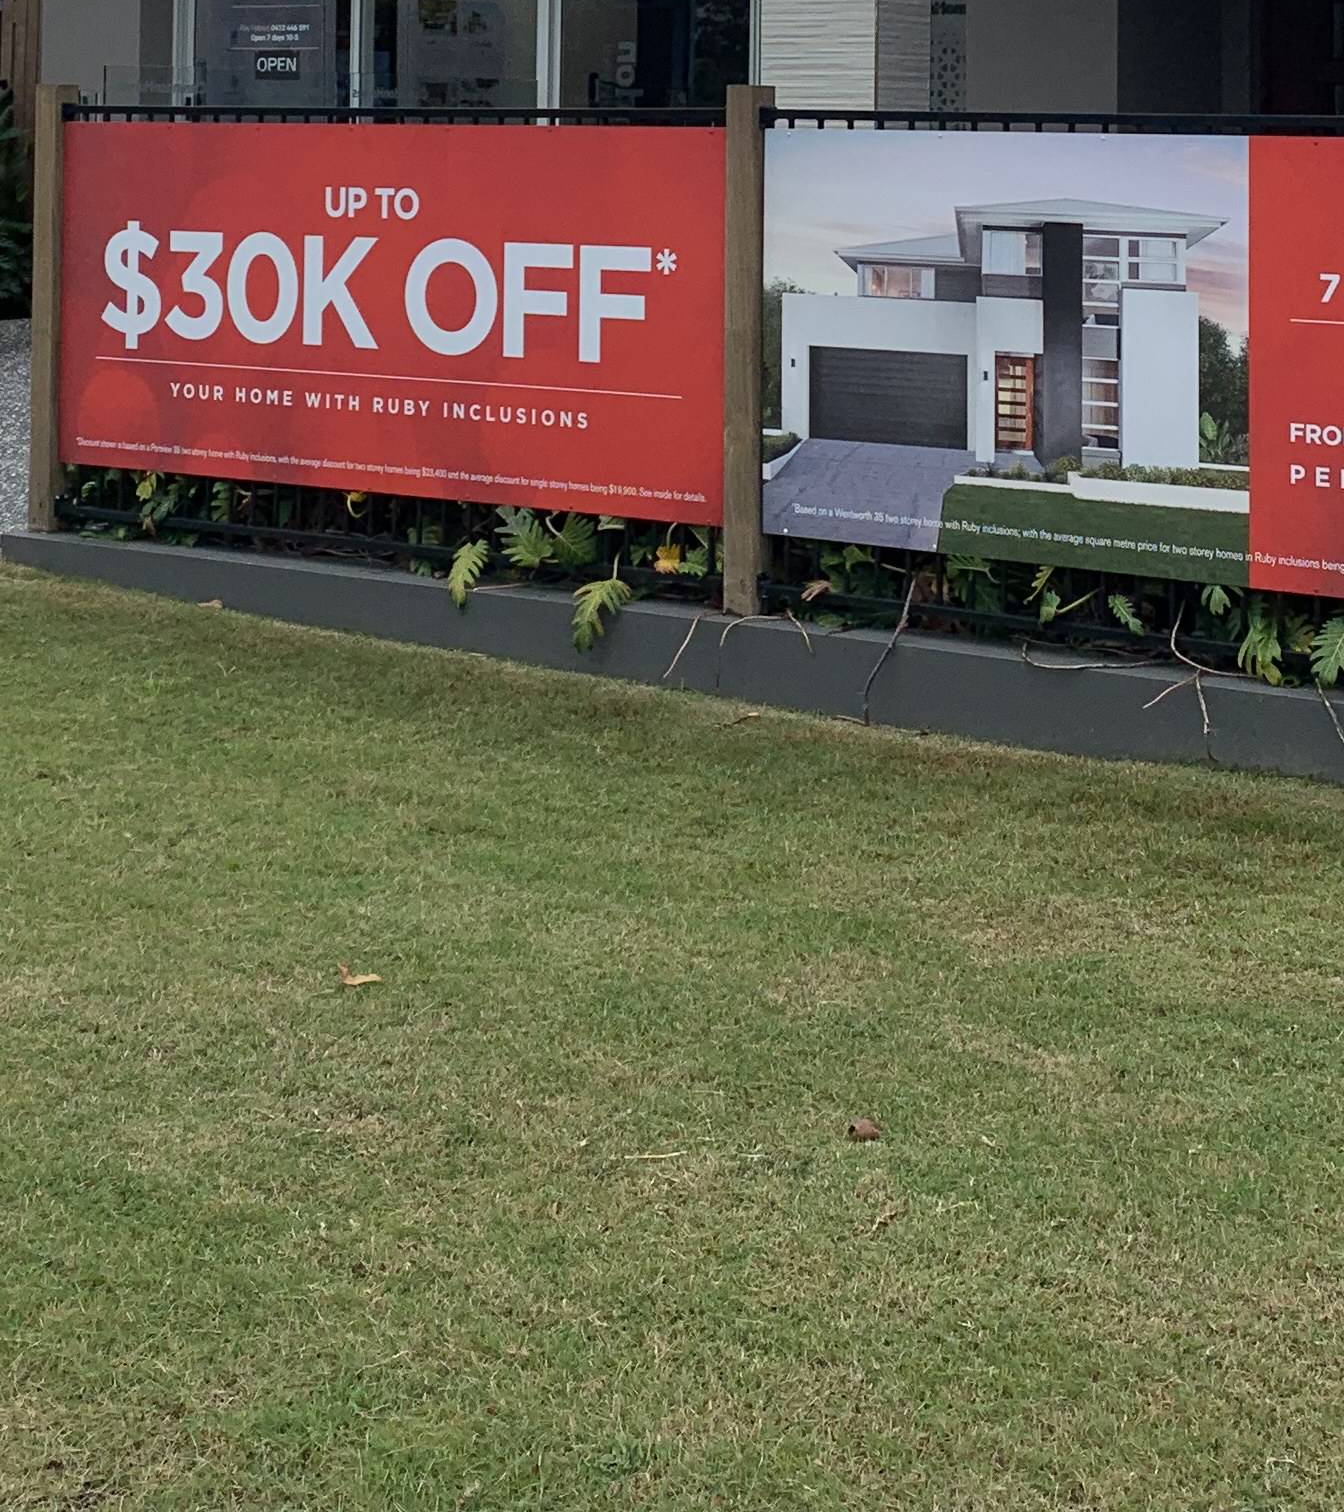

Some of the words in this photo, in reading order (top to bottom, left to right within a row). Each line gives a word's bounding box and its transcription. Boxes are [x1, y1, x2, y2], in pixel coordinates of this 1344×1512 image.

[256, 57, 297, 72] OPEN
[324, 186, 367, 219] UP
[374, 187, 420, 220] TO
[101, 220, 380, 350] $30K
[1319, 273, 1341, 304] 7
[170, 382, 224, 402] YOUR
[235, 387, 294, 407] HOME
[305, 392, 360, 412] WITH
[372, 396, 430, 418] RUBY
[443, 401, 589, 430] INCLUSIONS
[885, 513, 899, 523] two
[900, 516, 922, 529] storey
[923, 517, 943, 529] home
[944, 519, 961, 531] with
[962, 520, 981, 535] Ruby
[1022, 528, 1039, 540] with
[1040, 528, 1052, 541] the
[1053, 533, 1084, 547] average
[1085, 536, 1112, 549] square
[1112, 538, 1136, 550] metre
[1137, 540, 1158, 553] price
[1159, 541, 1170, 553] for
[1171, 544, 1188, 556] two
[1189, 546, 1215, 561] storey
[1215, 548, 1244, 562] homes
[1245, 551, 1253, 562] in
[1254, 551, 1277, 568] Ruby
[1278, 556, 1320, 570] inclusions
